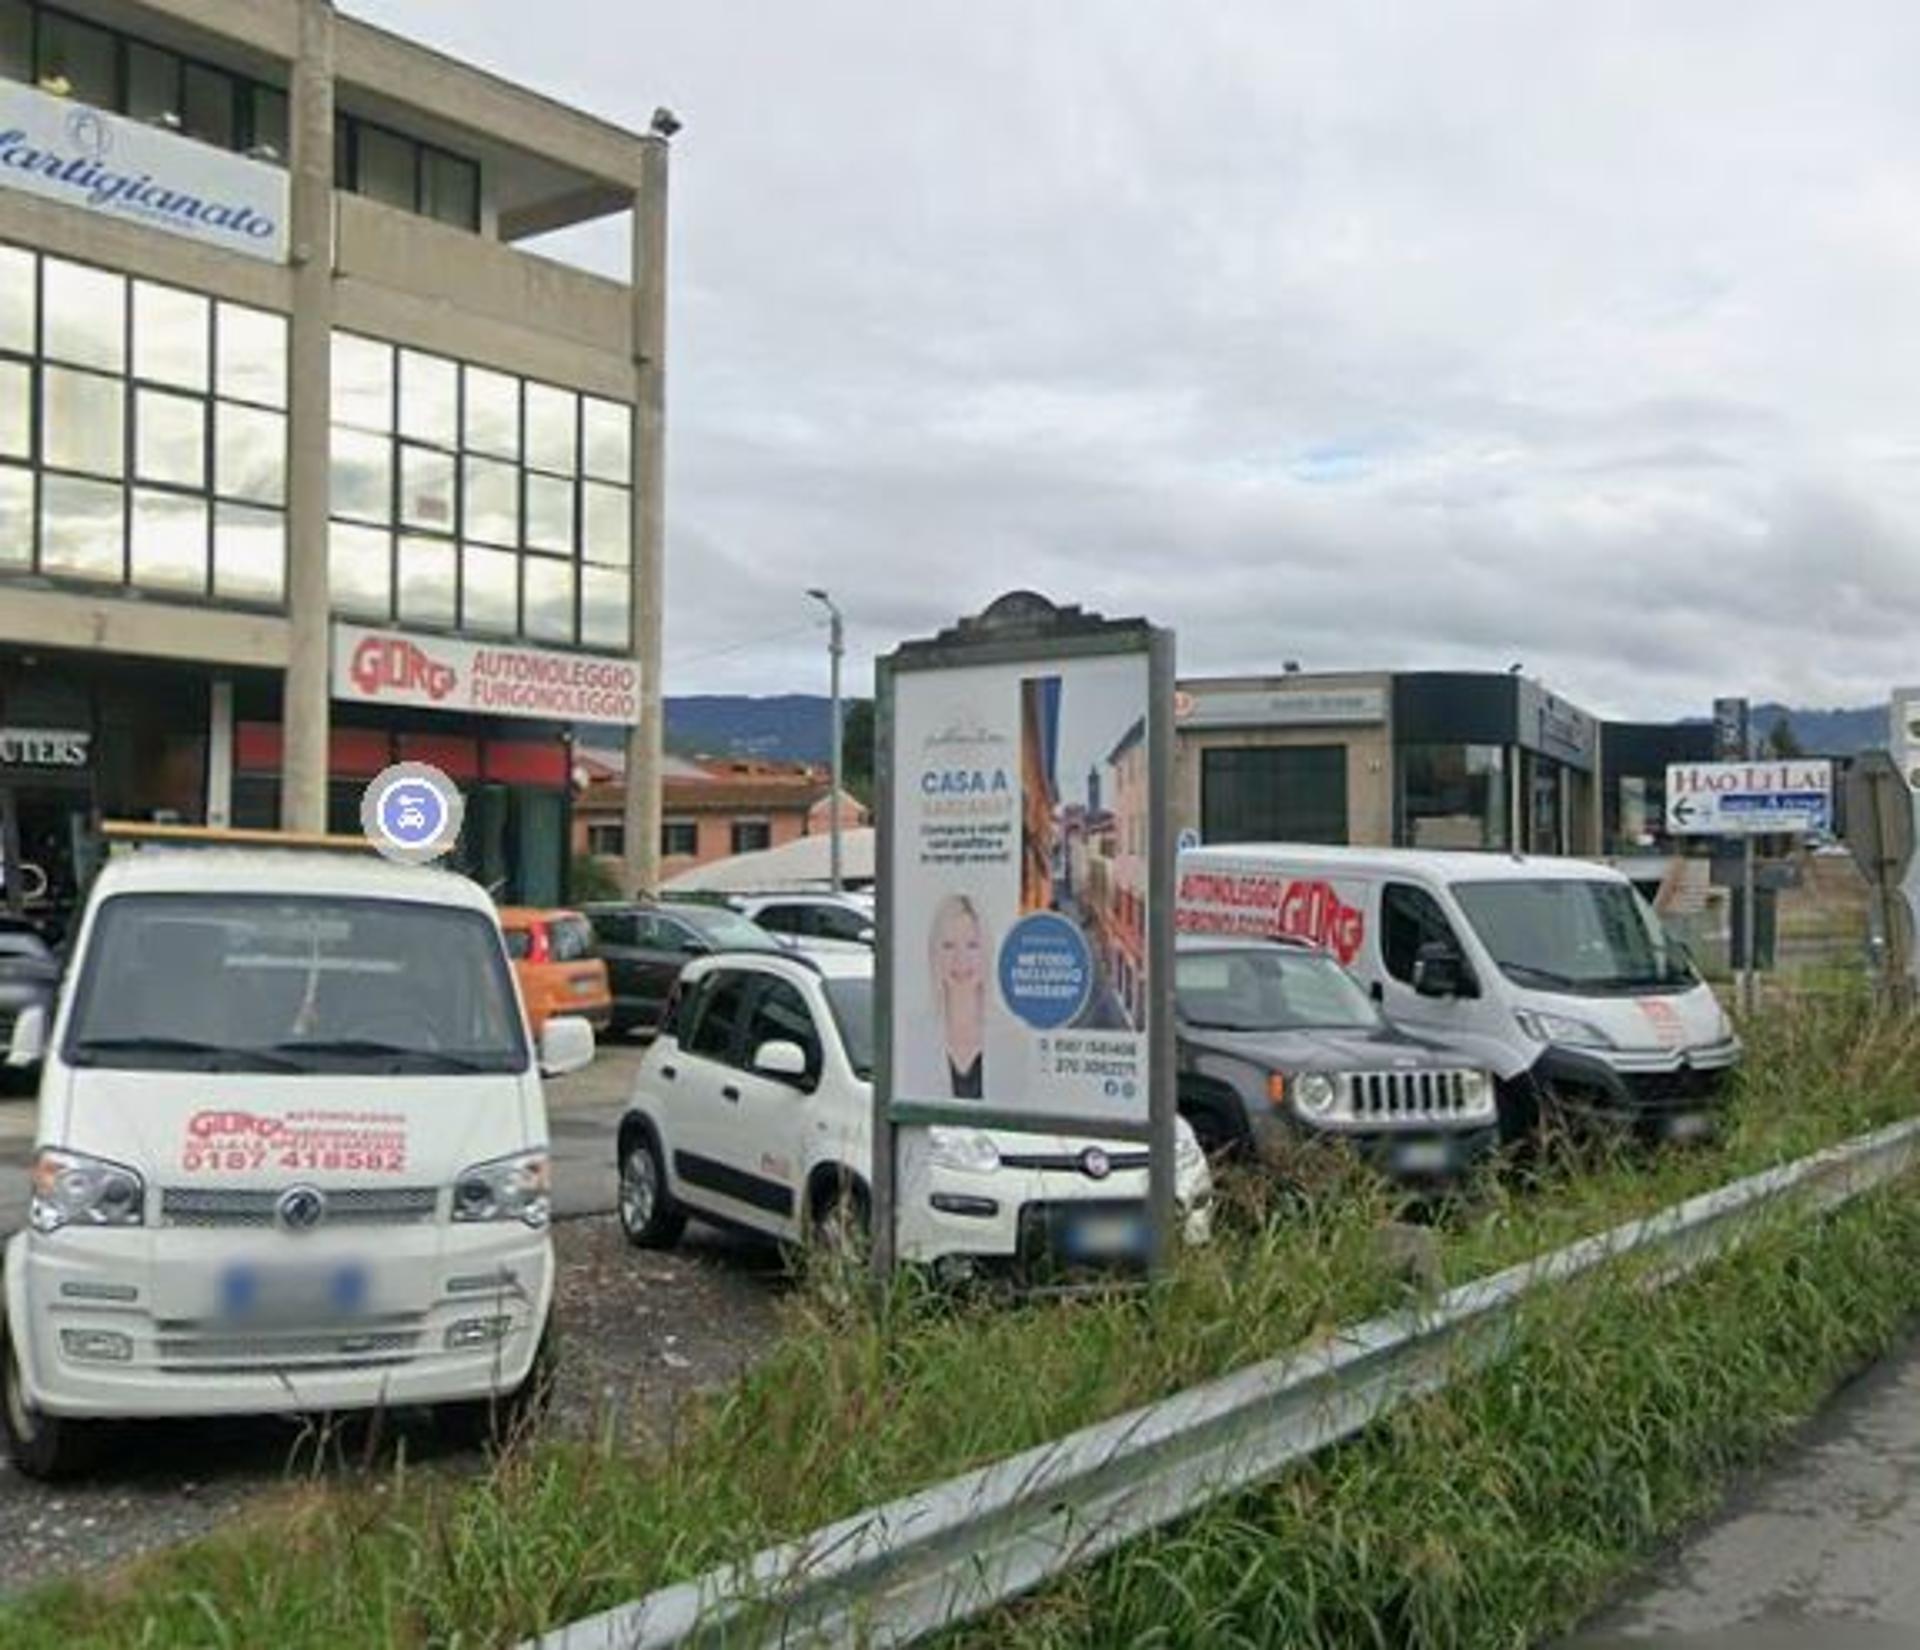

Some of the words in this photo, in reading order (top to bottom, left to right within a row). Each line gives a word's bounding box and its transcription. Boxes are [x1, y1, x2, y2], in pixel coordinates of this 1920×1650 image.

[472, 650, 635, 692] AUTONOLEGGIO
[471, 681, 636, 718] FURGONOLEGGIO
[921, 769, 987, 795] CASA
[991, 766, 1008, 793] A
[184, 1151, 267, 1172] 0187
[279, 1151, 405, 1173] 418582
